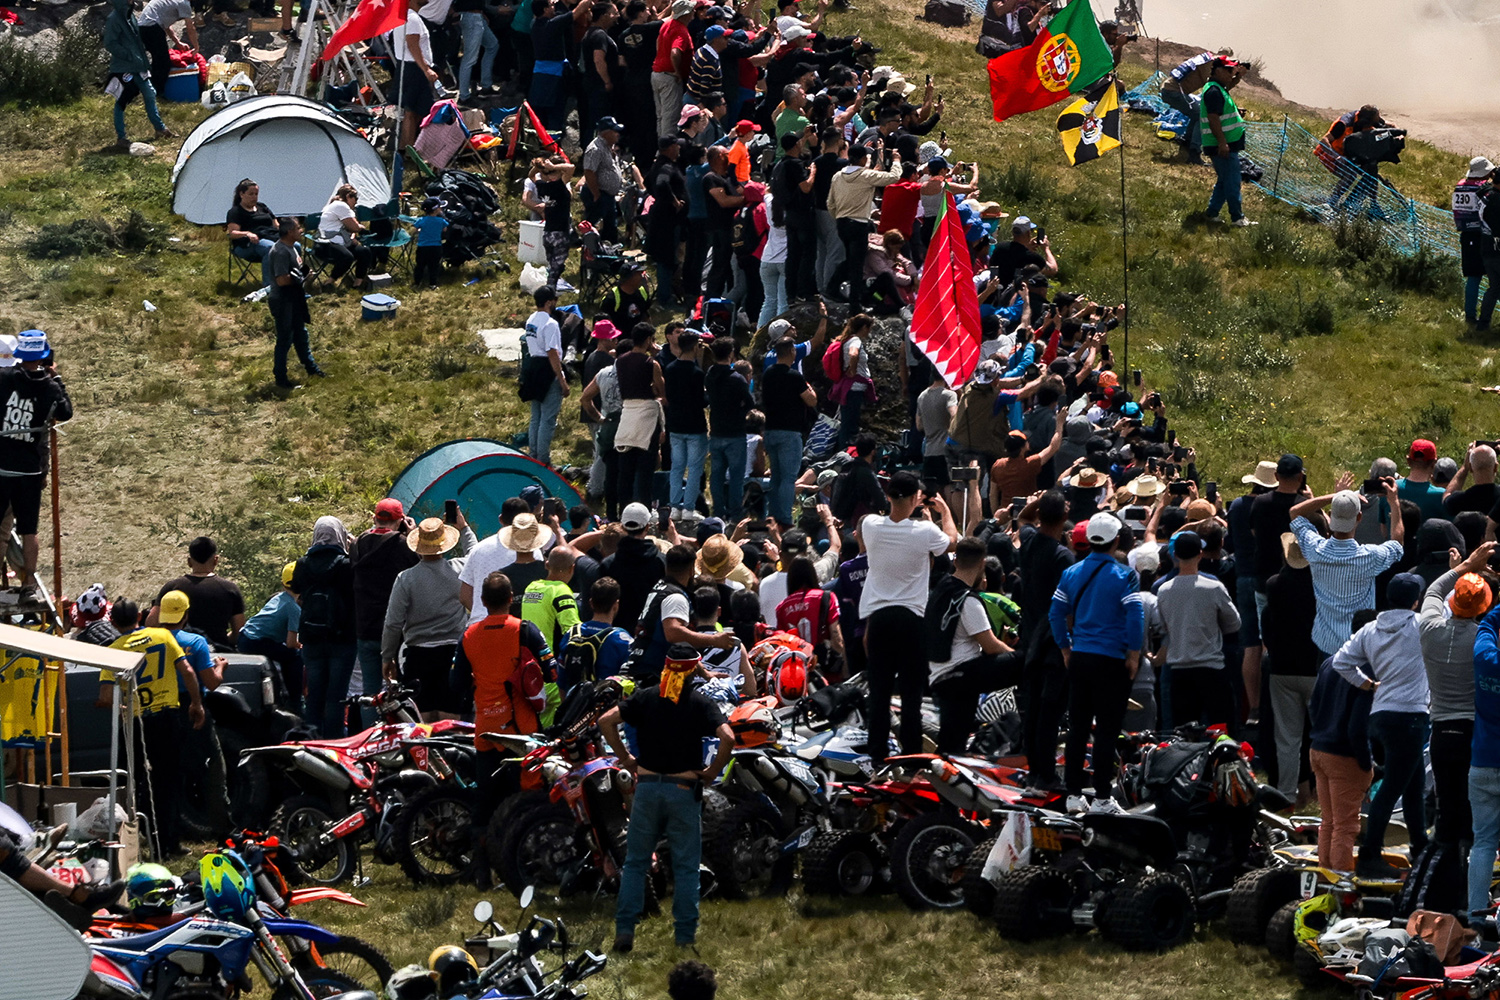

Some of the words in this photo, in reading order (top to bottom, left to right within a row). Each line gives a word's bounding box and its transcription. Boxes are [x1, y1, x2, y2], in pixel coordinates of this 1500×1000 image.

[1455, 194, 1470, 204] 230
[136, 643, 166, 686] 27
[187, 923, 250, 936] SHERCO
